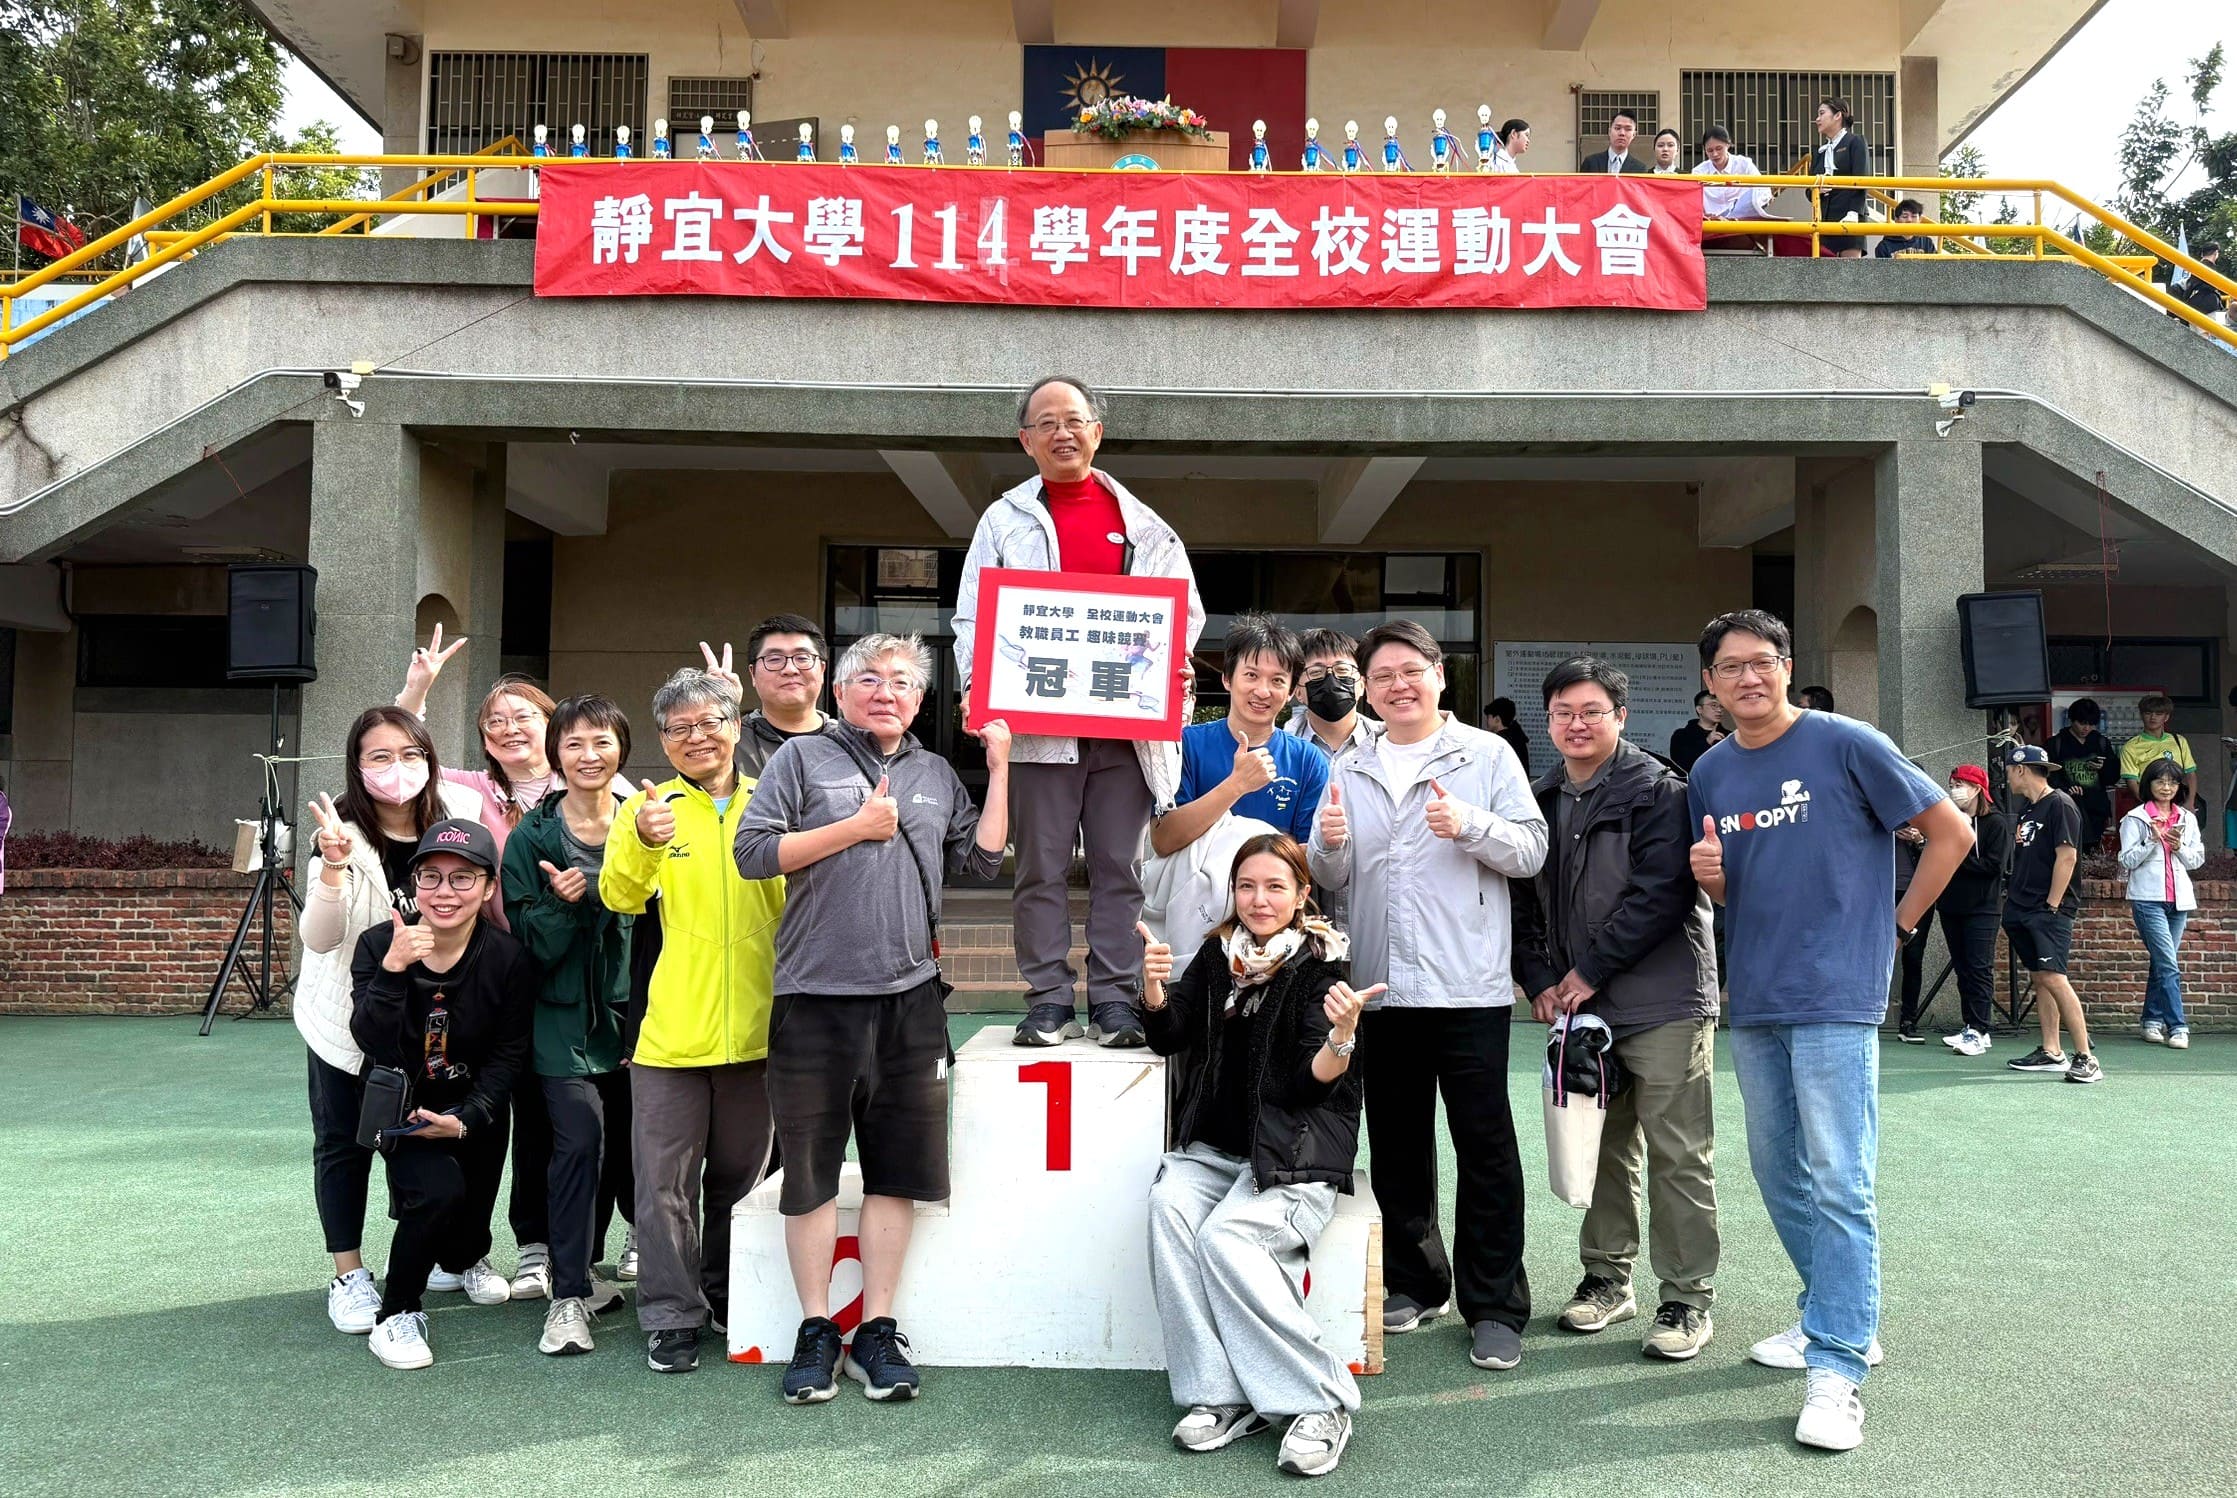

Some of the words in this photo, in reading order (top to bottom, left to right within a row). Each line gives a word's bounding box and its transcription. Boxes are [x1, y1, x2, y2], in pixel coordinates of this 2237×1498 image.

[1023, 604, 1075, 619] 靜宜大學
[1086, 608, 1164, 625] 全校運動大會
[1019, 625, 1079, 642] 教職員工
[1018, 1061, 1073, 1171] 1
